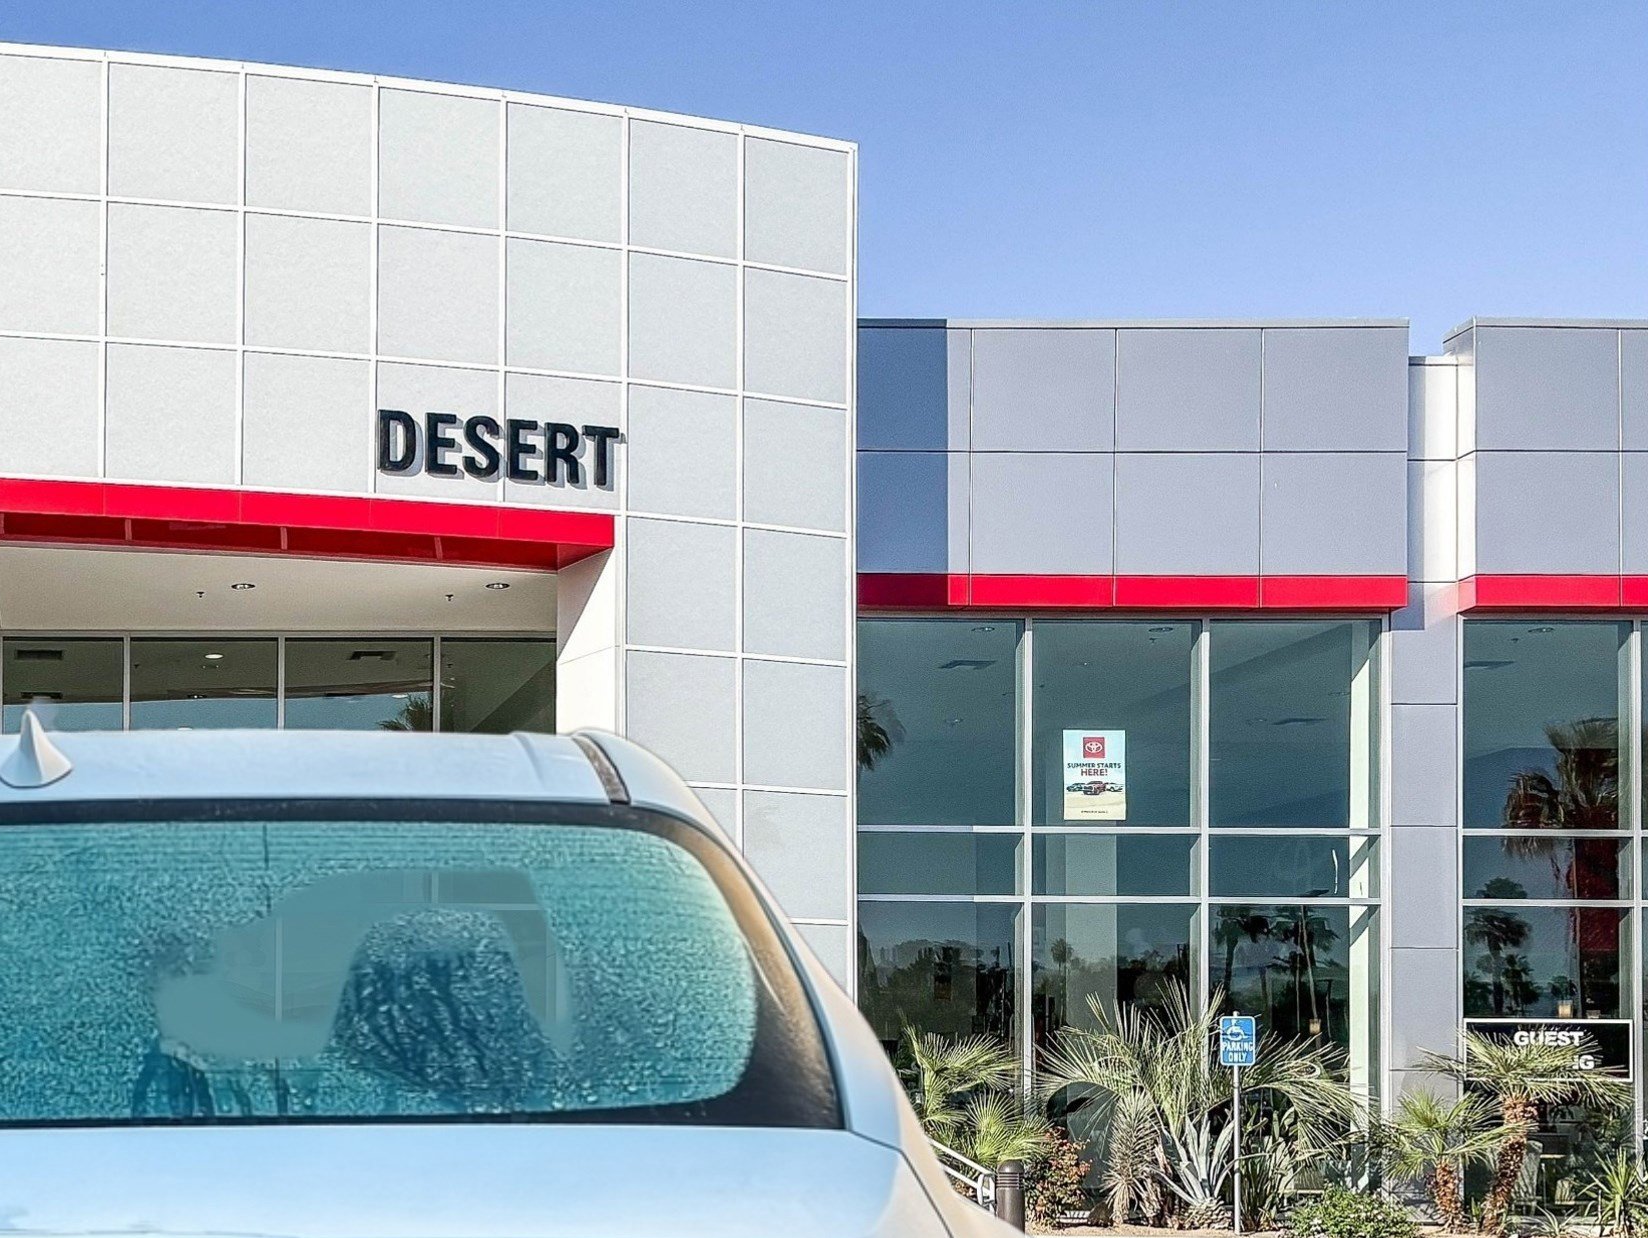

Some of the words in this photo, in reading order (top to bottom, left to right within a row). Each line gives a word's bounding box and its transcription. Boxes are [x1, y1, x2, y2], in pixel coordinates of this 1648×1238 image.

[377, 409, 620, 487] DESERT
[1080, 768, 1108, 777] HERE!
[1513, 1031, 1584, 1047] GUEST
[1222, 1041, 1253, 1051] PARKING
[1228, 1051, 1248, 1063] ONLY
